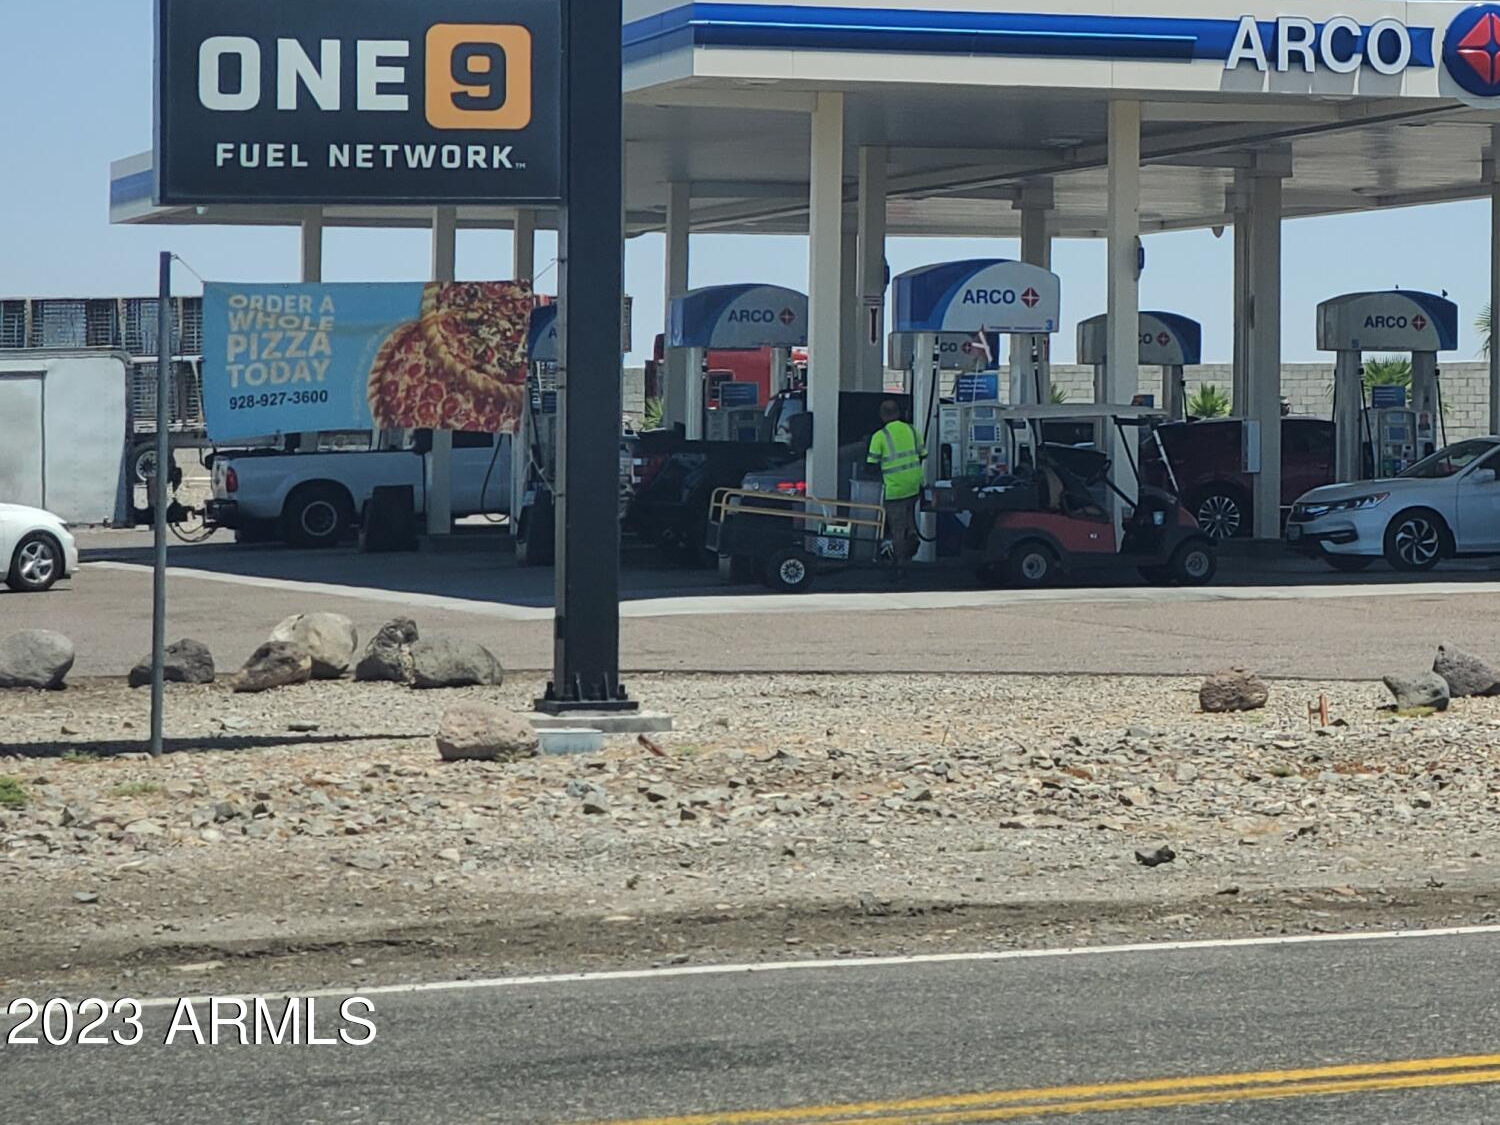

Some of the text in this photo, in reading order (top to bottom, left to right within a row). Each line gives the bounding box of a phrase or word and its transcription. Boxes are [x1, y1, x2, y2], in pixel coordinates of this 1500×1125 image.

[1225, 15, 1412, 76] ARCO
[198, 36, 507, 111] ONE 9
[216, 143, 308, 168] FUEL
[329, 144, 513, 169] NETWORK
[228, 294, 335, 314] ORDER A
[962, 289, 1016, 304] ARCO
[228, 311, 335, 332] WHOLE
[728, 309, 774, 323] ARCO
[1363, 315, 1408, 329] ARCO
[227, 331, 332, 362] PIZZA
[225, 359, 331, 388] TODAY
[229, 390, 328, 410] 928-927-3600
